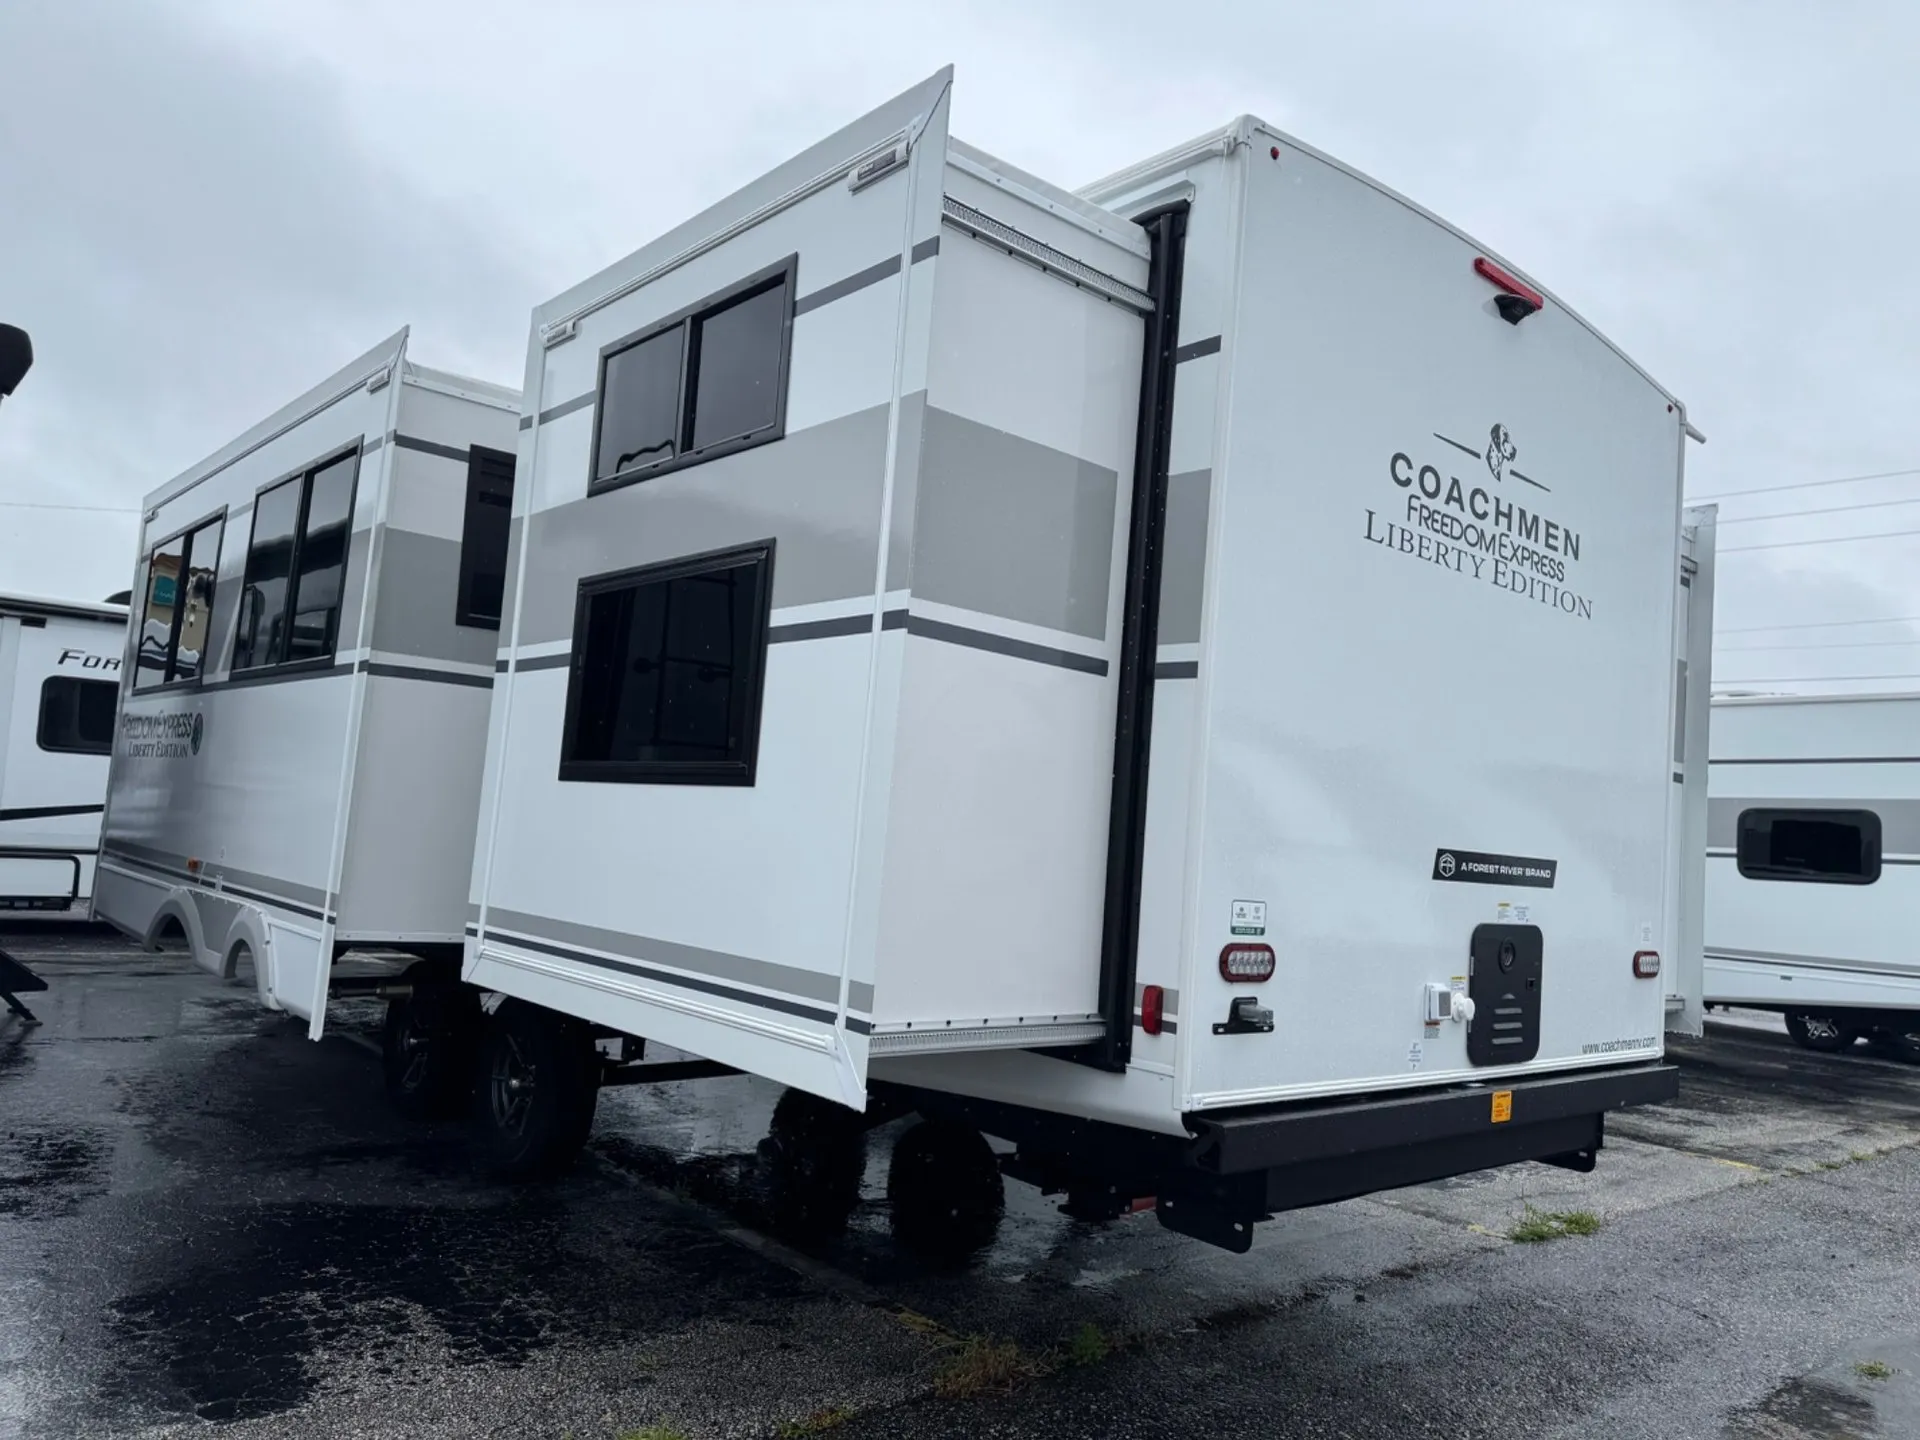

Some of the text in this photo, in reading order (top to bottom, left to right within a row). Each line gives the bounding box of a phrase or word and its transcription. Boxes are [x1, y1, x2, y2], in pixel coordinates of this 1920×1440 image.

[1390, 452, 1580, 561] COACHMEN
[1364, 508, 1593, 620] LIBERTY EDITION
[1460, 862, 1467, 871] A
[1468, 862, 1500, 873] FOREST
[1525, 868, 1551, 878] BRAND
